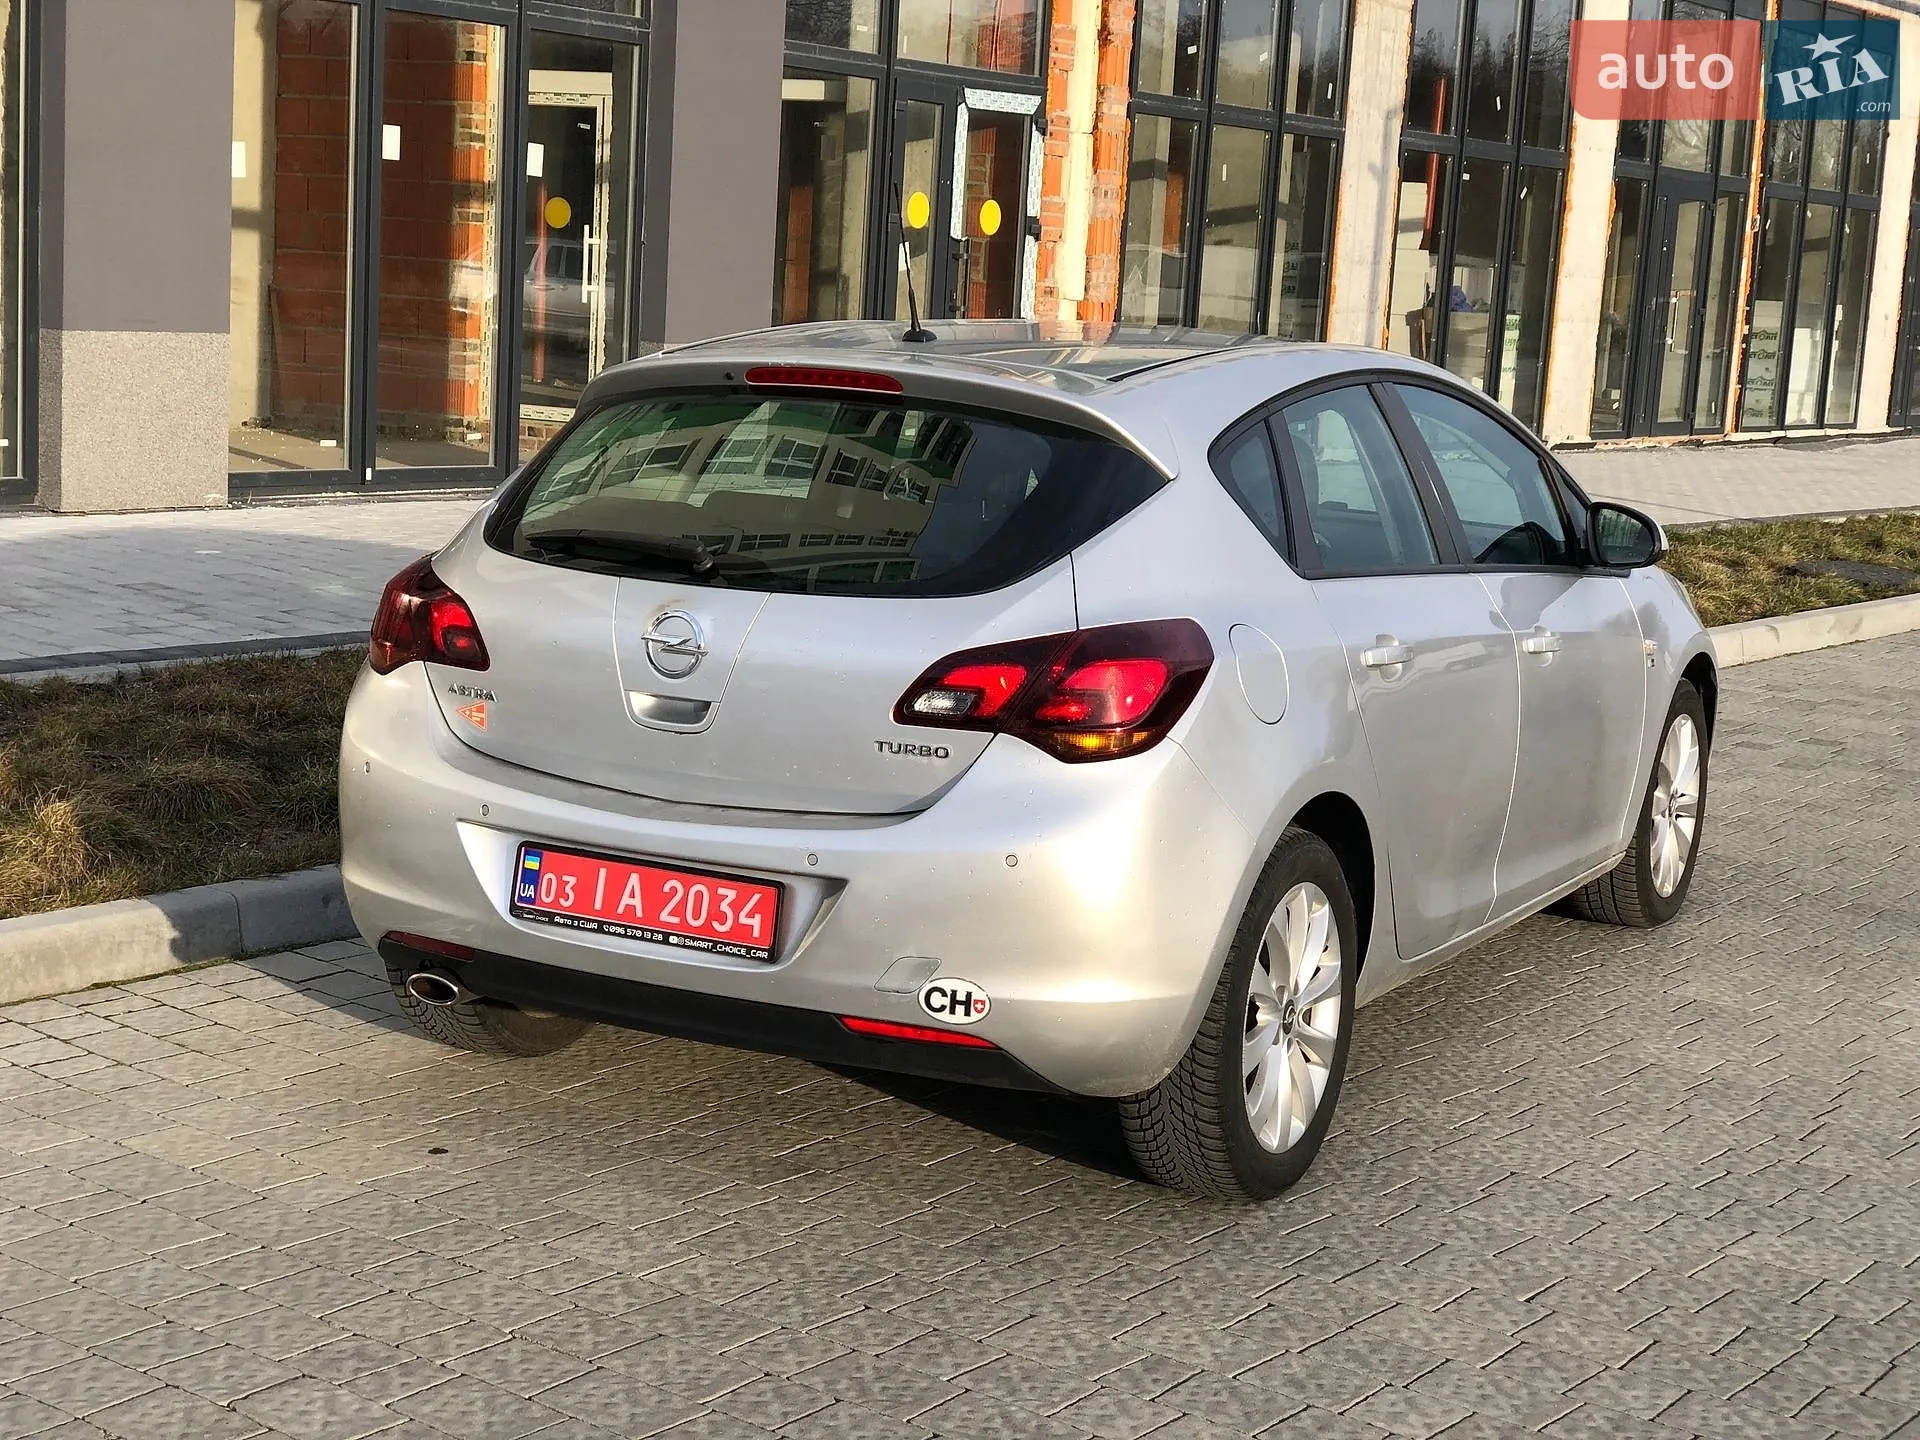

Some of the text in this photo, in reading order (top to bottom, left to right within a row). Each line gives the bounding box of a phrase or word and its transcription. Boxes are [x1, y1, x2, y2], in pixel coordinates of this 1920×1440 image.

[448, 683, 498, 703] ASTRA
[874, 740, 950, 759] TURBO
[519, 882, 535, 899] UA
[540, 872, 577, 908] 03
[659, 879, 762, 938] 2034
[609, 925, 663, 941] 096 570 13 28
[924, 986, 973, 1017] CH
